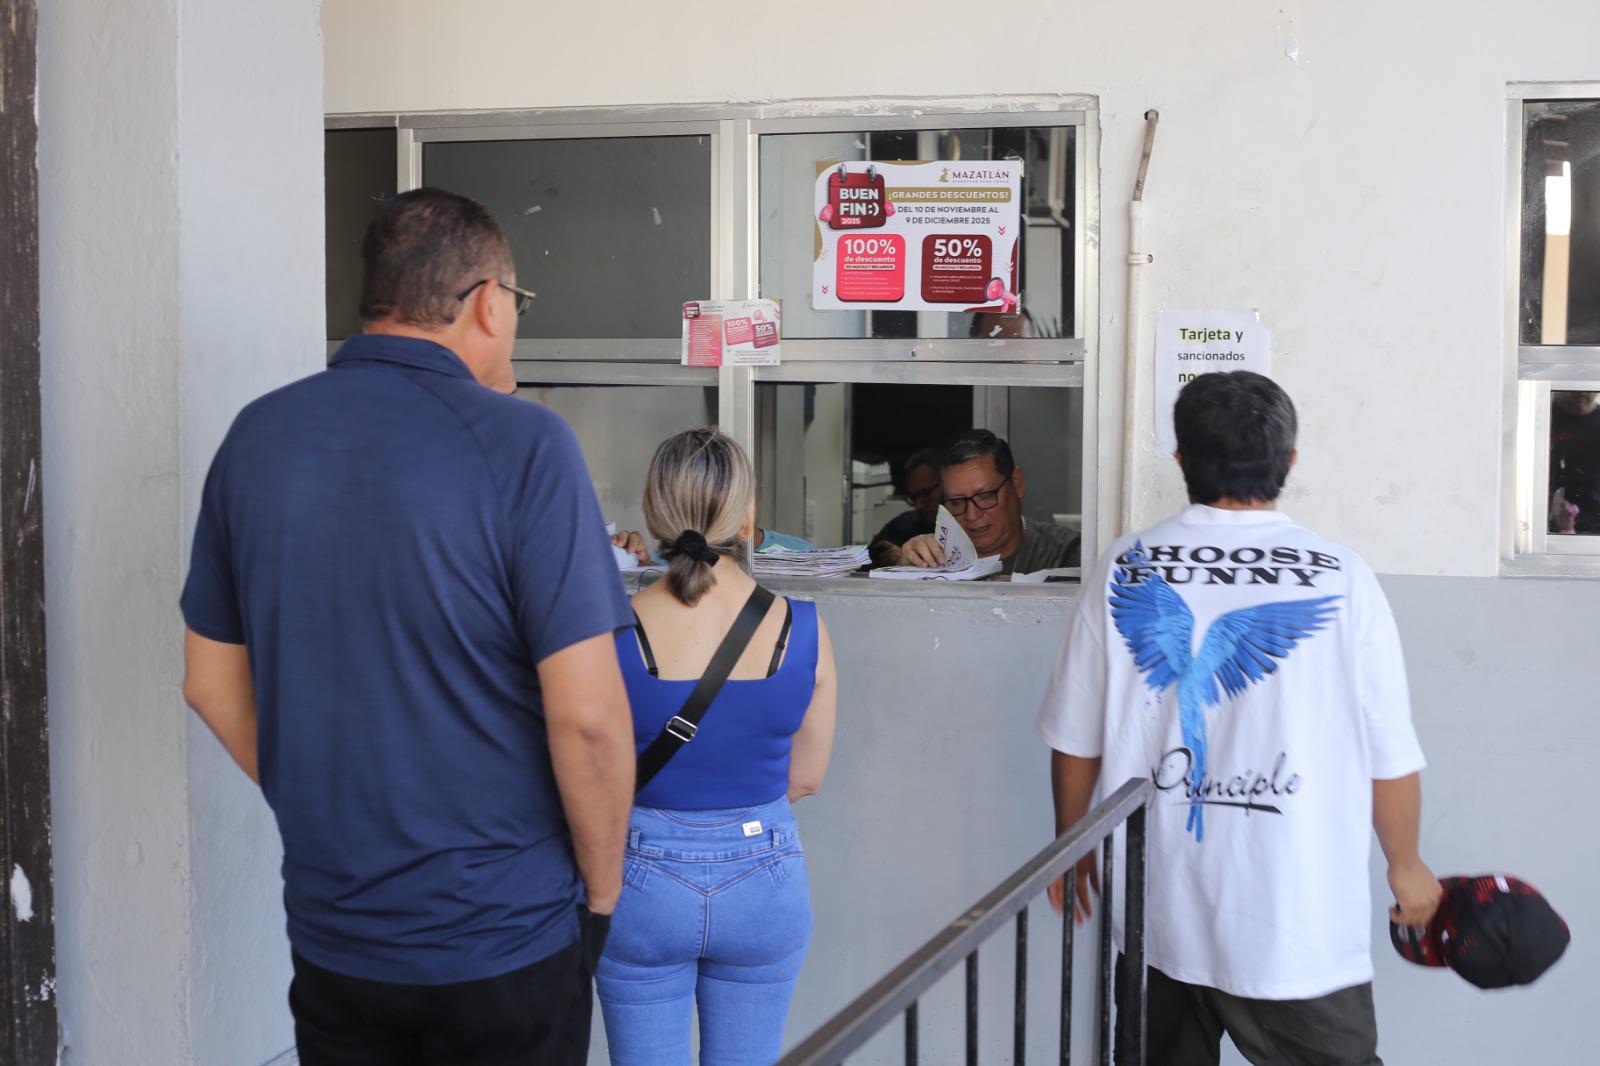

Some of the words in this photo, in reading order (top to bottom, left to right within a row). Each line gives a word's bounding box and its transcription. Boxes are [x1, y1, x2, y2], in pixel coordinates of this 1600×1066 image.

[839, 188, 879, 200] BUEN
[888, 191, 938, 201] ¡GRANDES
[940, 191, 1009, 199] DESCUENTOS!
[970, 217, 991, 225] 2025
[844, 239, 897, 255] 100%
[933, 239, 983, 257] 50%
[1180, 328, 1231, 343] Tarjeta
[1235, 331, 1243, 343] y
[1177, 351, 1245, 361] sancionados
